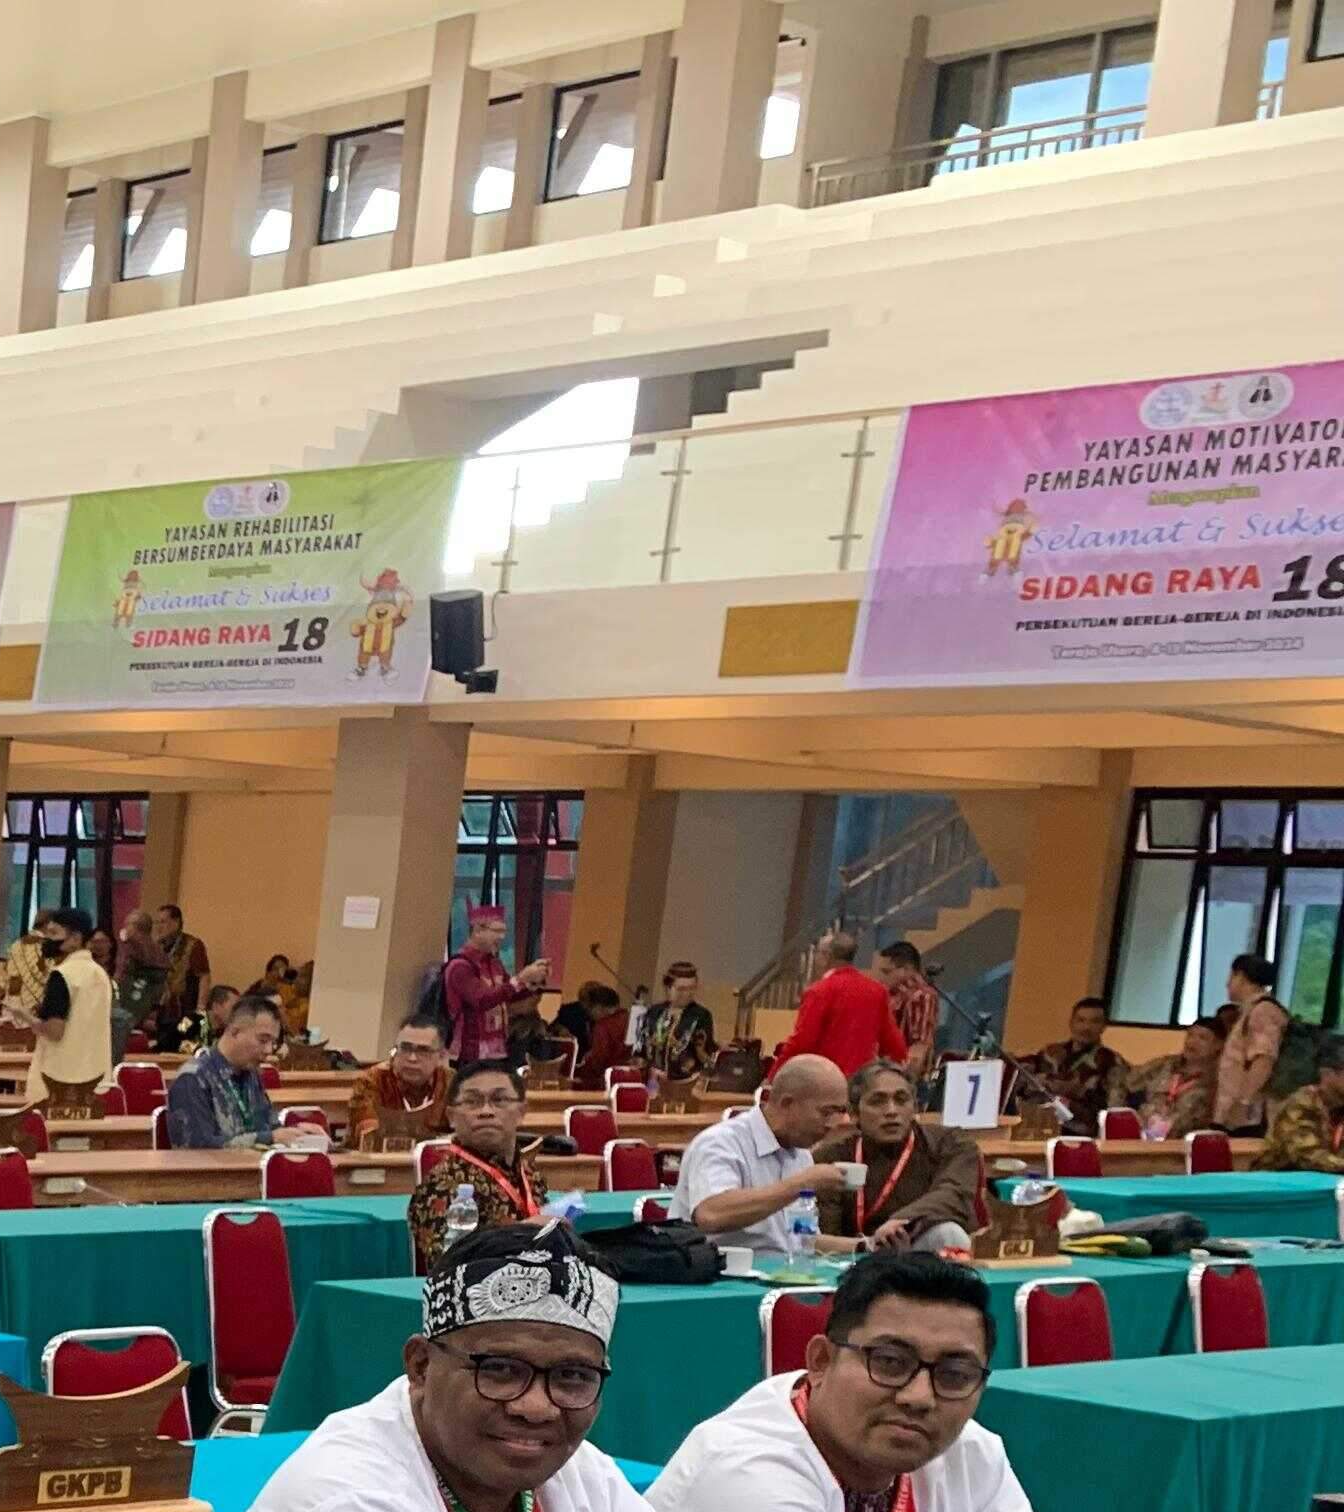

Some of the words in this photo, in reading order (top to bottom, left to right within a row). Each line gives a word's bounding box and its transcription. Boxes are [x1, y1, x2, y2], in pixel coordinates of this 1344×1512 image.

[1084, 431, 1194, 462] YAYASAN
[1204, 418, 1344, 452] MOTIVATO
[1023, 456, 1221, 494] PEMBANGUNAN
[165, 522, 228, 543] YAYASAN
[233, 514, 335, 538] REHABILITASI
[1028, 519, 1193, 555] Selamat
[133, 541, 254, 566] BERSUMBERDAYA
[259, 532, 364, 556] MASYARAKAT
[1019, 571, 1154, 601] SIDANG
[1166, 564, 1261, 595] RAYA
[131, 628, 211, 649] SIDANG
[217, 623, 272, 645] RAYA
[277, 616, 330, 653] 18
[47, 1471, 123, 1498] GKPB
